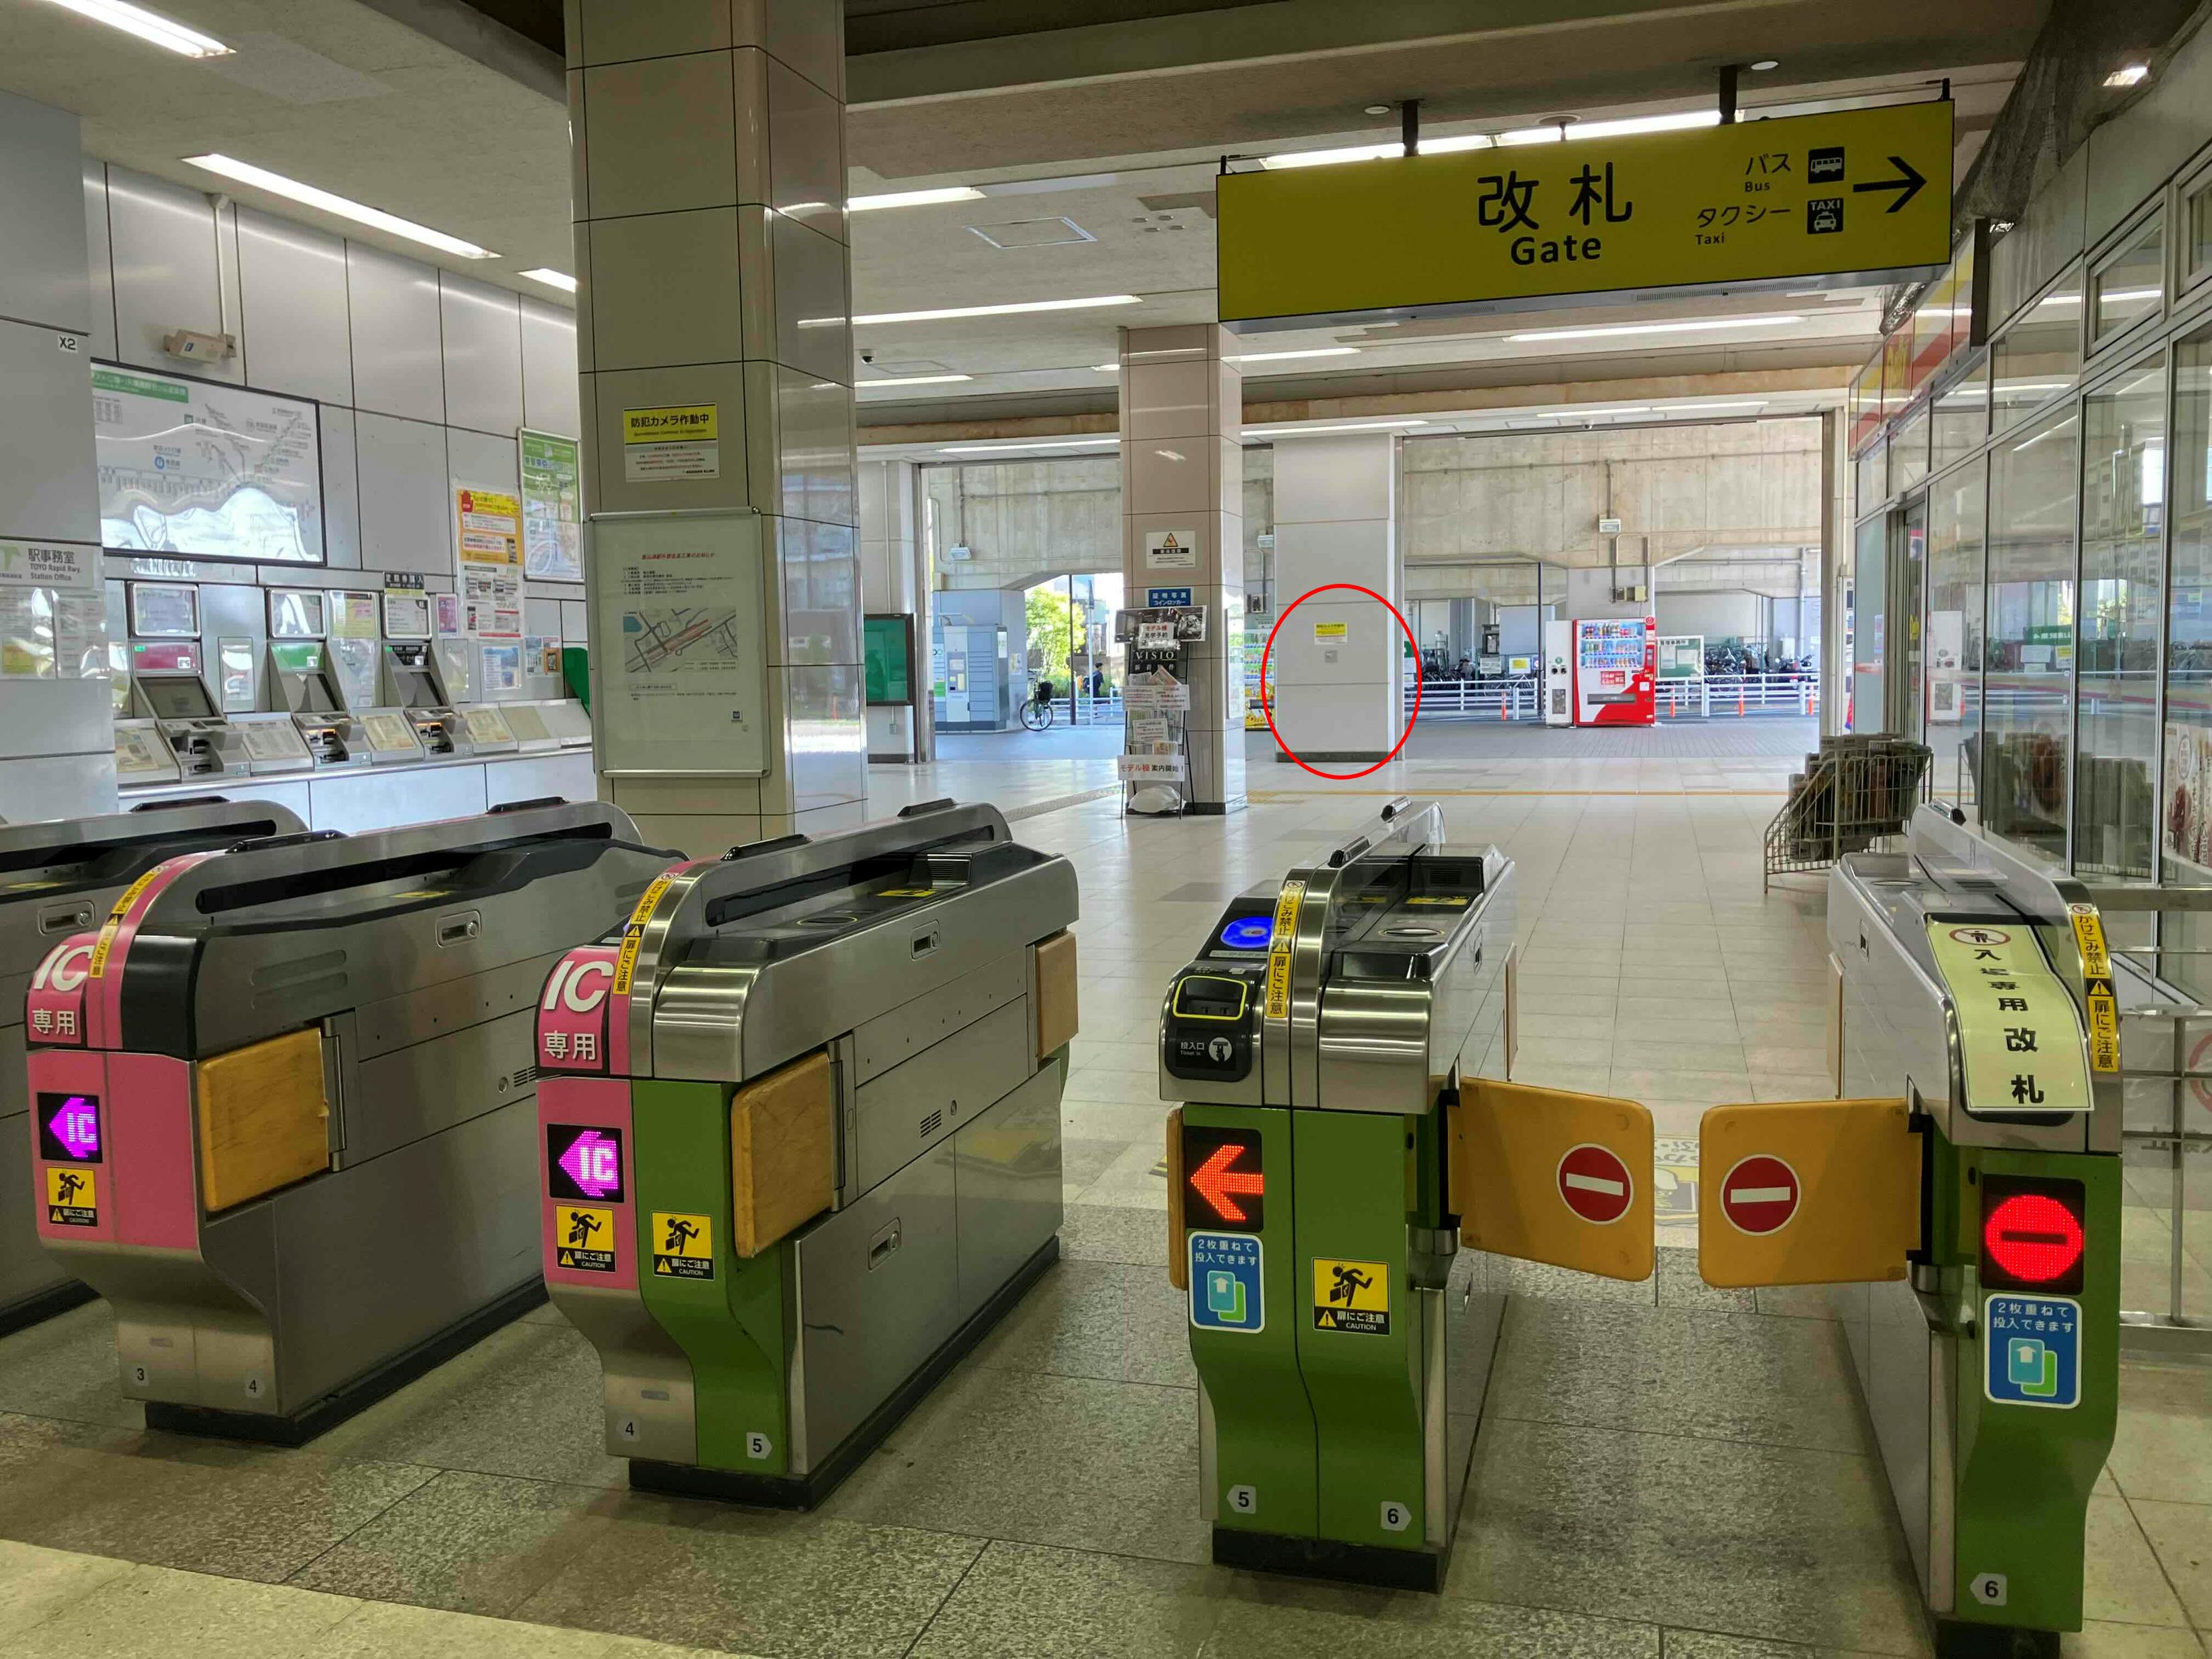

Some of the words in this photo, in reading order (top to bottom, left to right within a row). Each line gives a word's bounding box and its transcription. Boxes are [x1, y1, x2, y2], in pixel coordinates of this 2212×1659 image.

[1745, 152, 1791, 177] バス
[1745, 180, 1770, 192] Bus
[1477, 162, 1634, 233] 改札
[1810, 199, 1841, 211] TAXI
[1696, 204, 1791, 229] タクシー
[1695, 232, 1725, 245] Taxi
[1510, 235, 1603, 265] Gate
[59, 336, 76, 351] X2
[631, 414, 709, 428] 防犯カメラ作動中
[28, 548, 74, 564] 駅事務室
[48, 564, 66, 572] Rapid
[1135, 651, 1174, 660] VISIO
[2079, 914, 2106, 975] かけこみ禁止
[34, 945, 96, 991] IC
[616, 939, 636, 992] 扉にご注意
[544, 961, 614, 1012] IC
[1270, 956, 1286, 1015] 扉にご注意
[32, 1008, 75, 1035] 専用
[2093, 999, 2113, 1068] 扉にご注意
[544, 1030, 597, 1060] 専用
[1180, 1041, 1205, 1050] 投入口
[67, 1113, 97, 1143] IC
[580, 1147, 614, 1181] IC
[1198, 1239, 1253, 1253] 2枚重ねて
[574, 1251, 612, 1262] 扉にご注意
[671, 1258, 710, 1270] 扉にご注意
[1194, 1251, 1257, 1266] 投入できます
[581, 1261, 606, 1269] CAUTION
[678, 1268, 704, 1276] CAUTION
[1337, 1310, 1386, 1324] 扉にご注意
[1998, 1302, 2070, 1318] 2枚重ねて
[1345, 1322, 1377, 1331] CAUTION
[1993, 1316, 2074, 1333] 投入できます
[137, 1368, 145, 1381] 3
[249, 1379, 257, 1393] 4
[625, 1422, 635, 1436] 4
[752, 1438, 762, 1453] 5
[1238, 1491, 1249, 1508] 5
[1387, 1508, 1399, 1525] 6
[1985, 1580, 1999, 1598] 6
